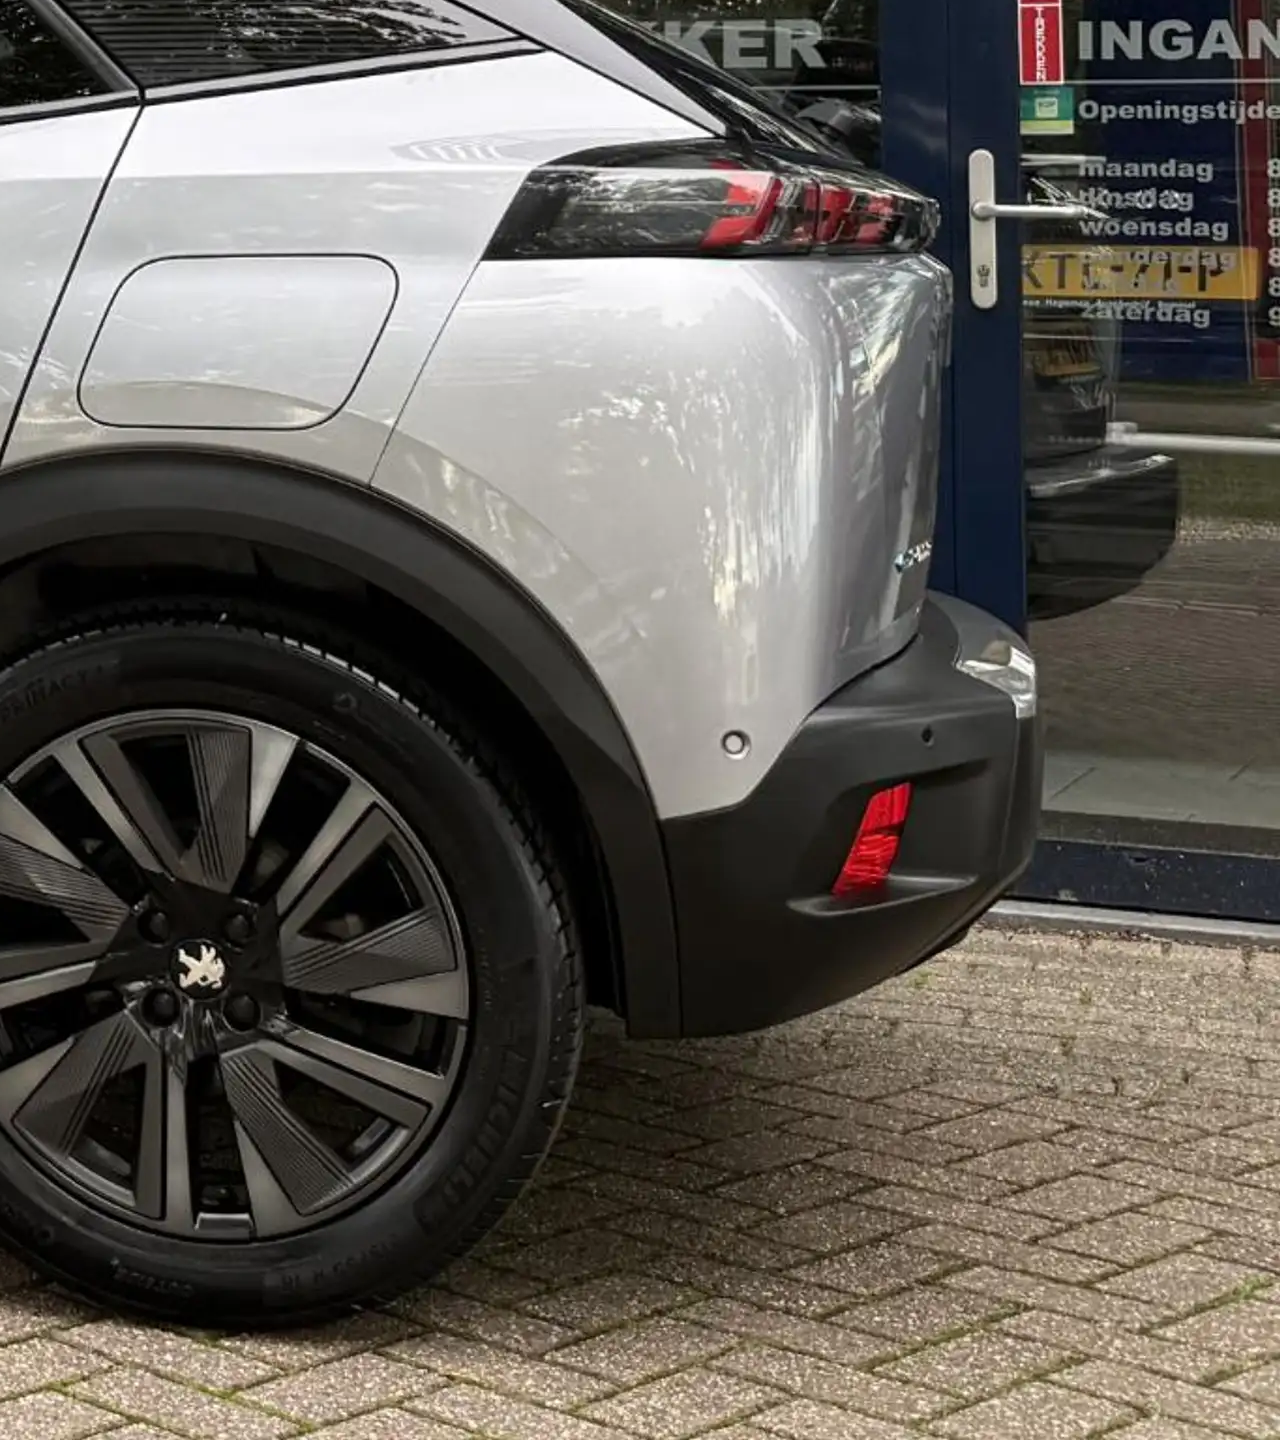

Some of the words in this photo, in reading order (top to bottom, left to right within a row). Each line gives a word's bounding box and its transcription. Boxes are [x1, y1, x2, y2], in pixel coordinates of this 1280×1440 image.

[642, 18, 827, 69] KER
[1078, 19, 1280, 61] INGAN
[1079, 159, 1214, 183] maandag
[1078, 218, 1229, 241] woensdag
[1080, 304, 1210, 328] zaterdag
